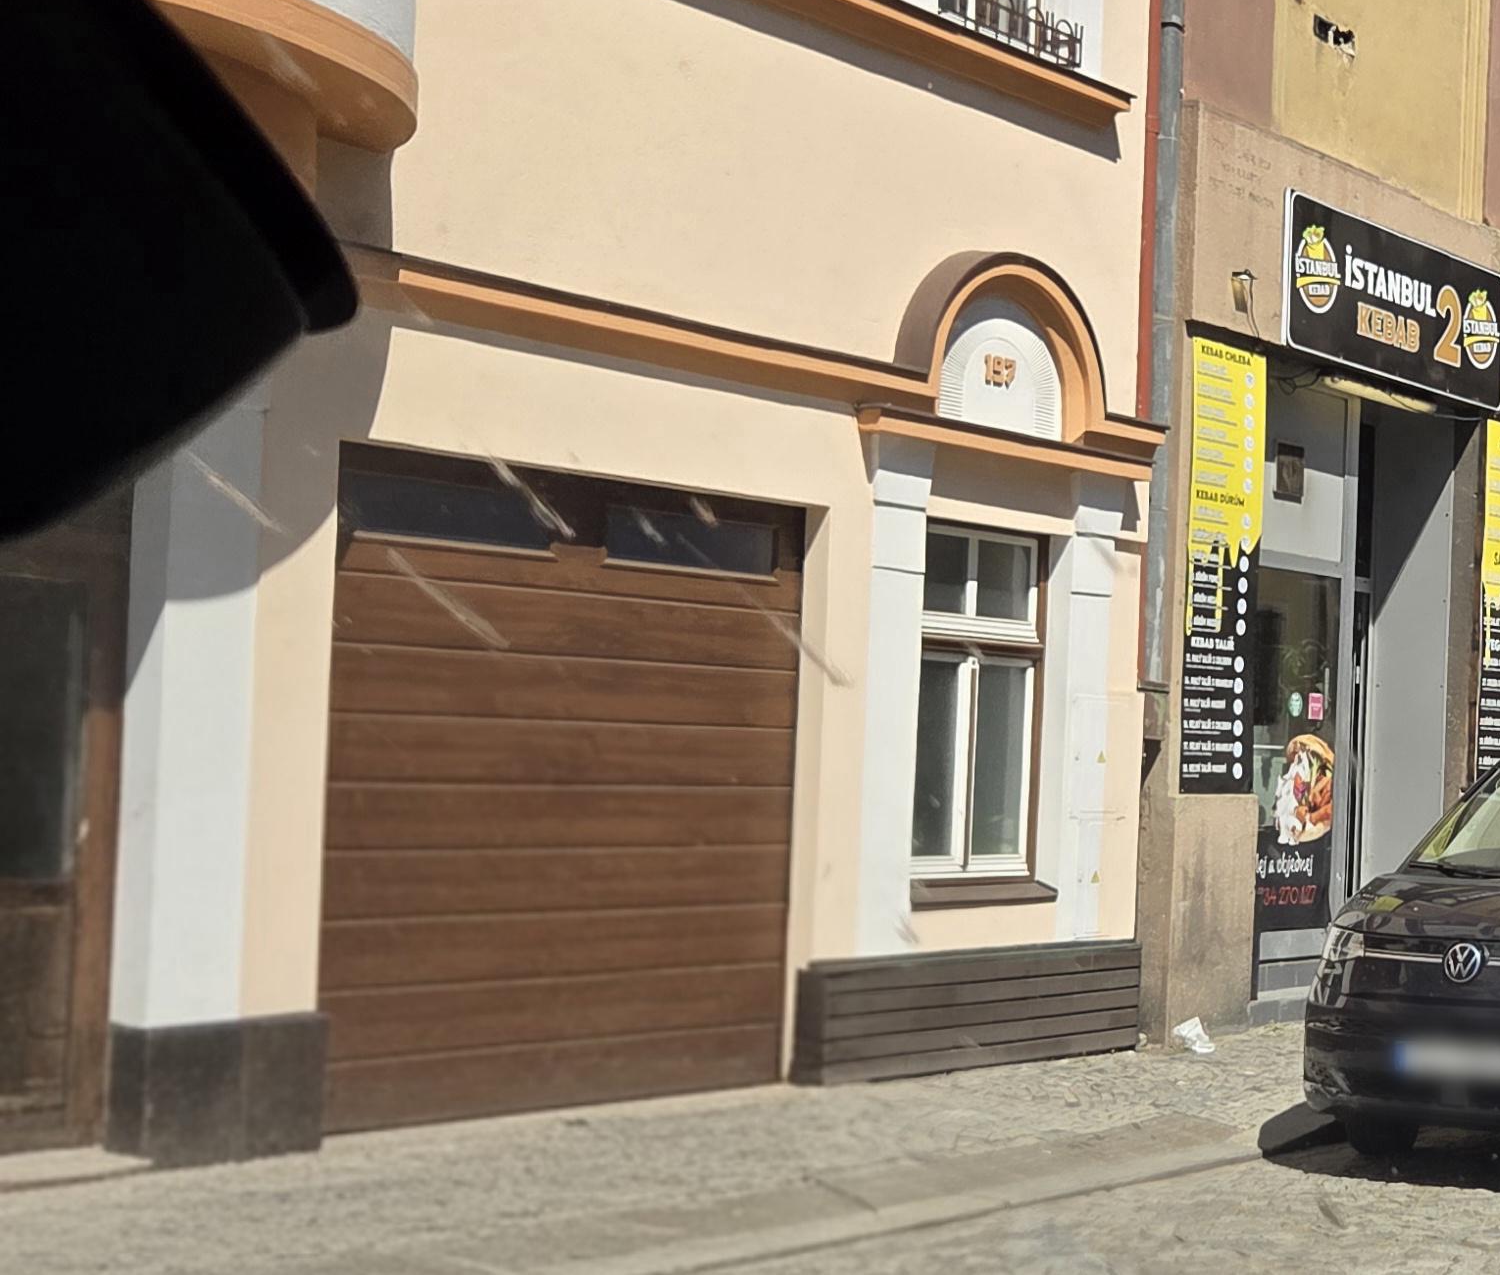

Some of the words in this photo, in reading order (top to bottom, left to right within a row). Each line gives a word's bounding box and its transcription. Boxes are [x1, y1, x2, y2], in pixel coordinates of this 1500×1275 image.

[1357, 301, 1421, 354] KEBAB
[1434, 285, 1462, 368] 2
[1201, 344, 1223, 360] KEBAB
[1196, 489, 1218, 503] KEBAB
